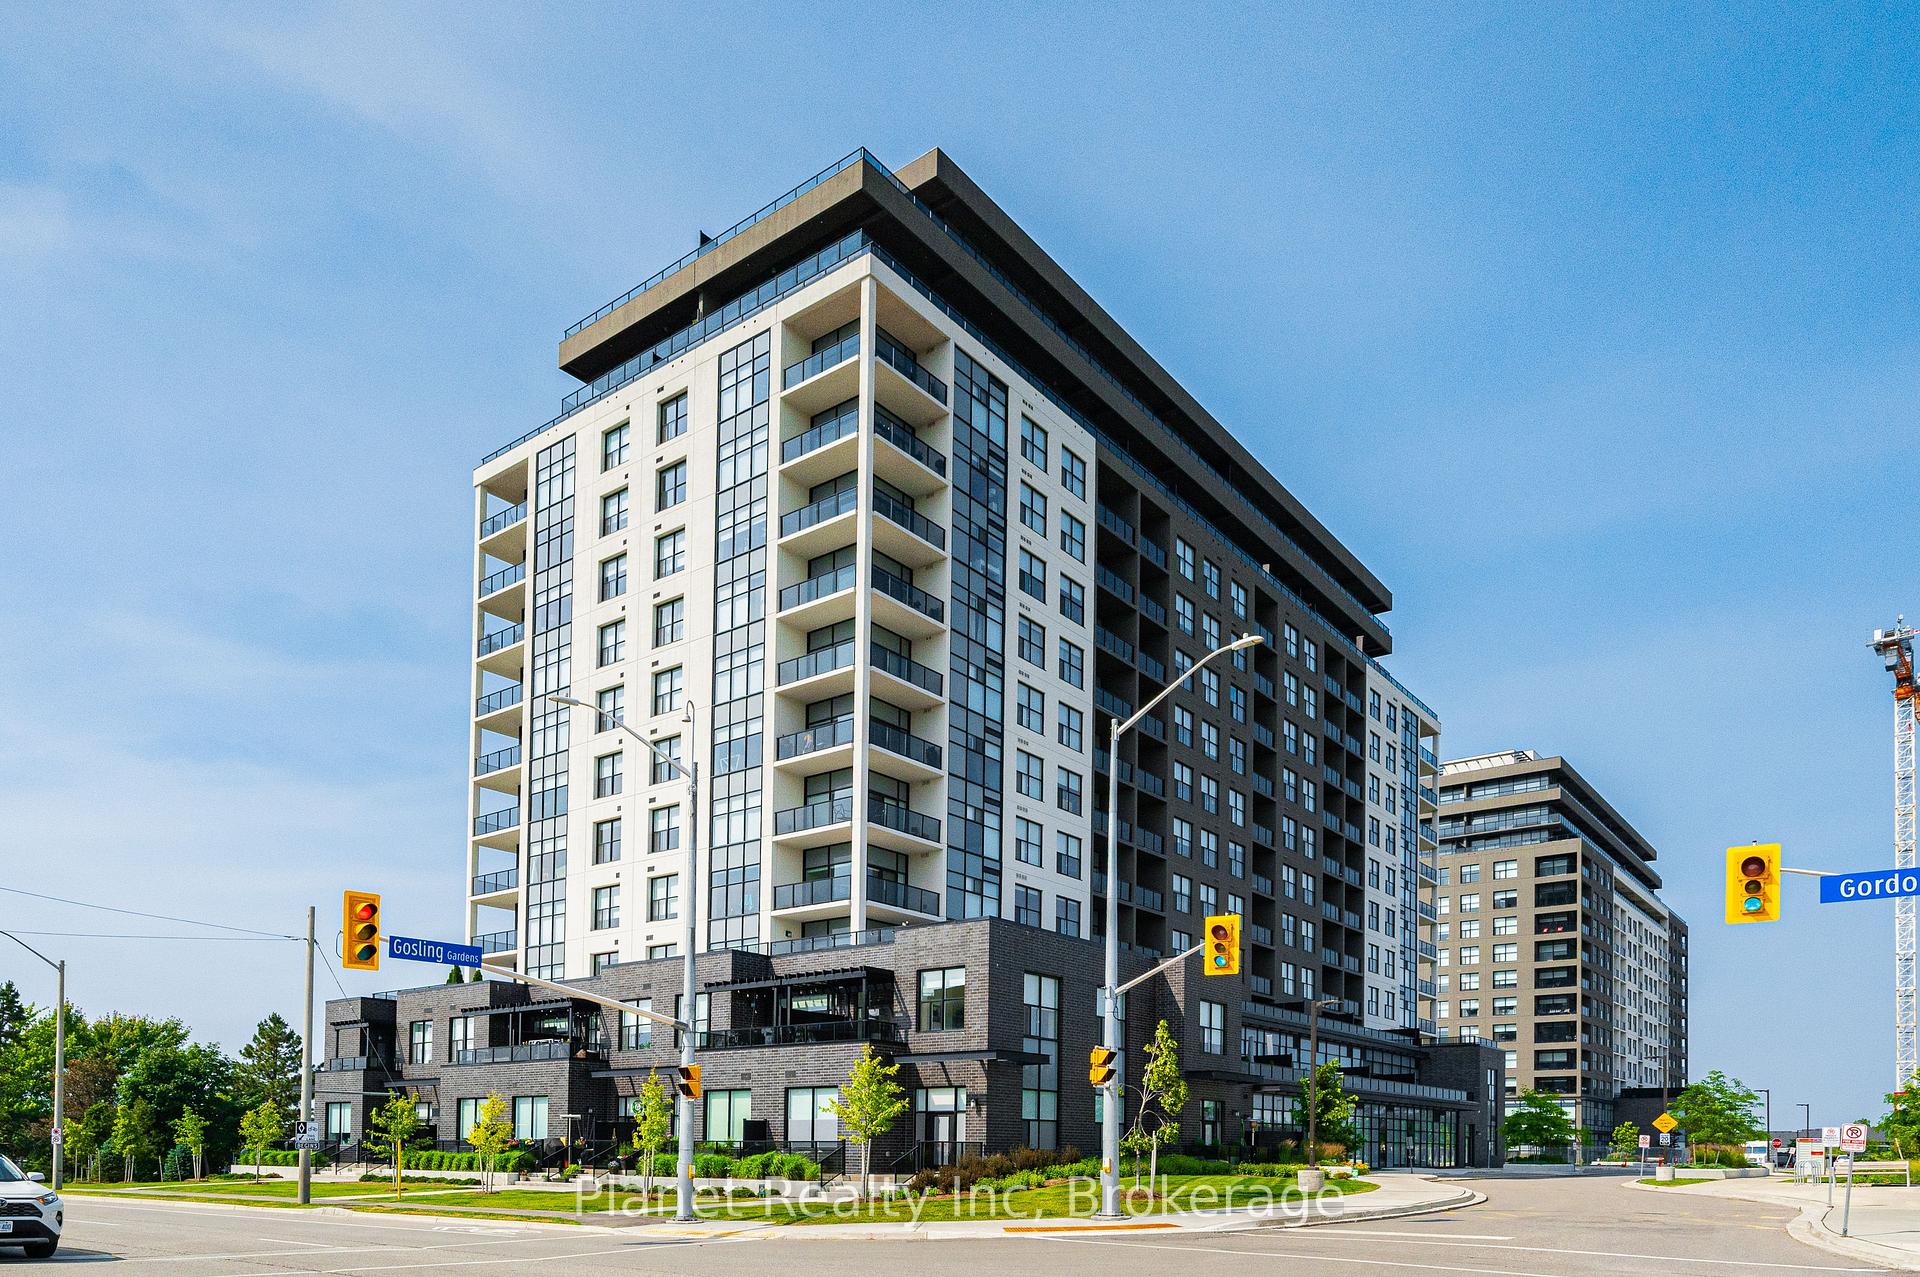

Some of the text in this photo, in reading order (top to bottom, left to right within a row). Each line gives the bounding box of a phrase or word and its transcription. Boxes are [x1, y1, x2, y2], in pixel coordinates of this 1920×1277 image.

[1840, 873, 1918, 898] Gordo
[393, 939, 479, 963] Gosling Gardens
